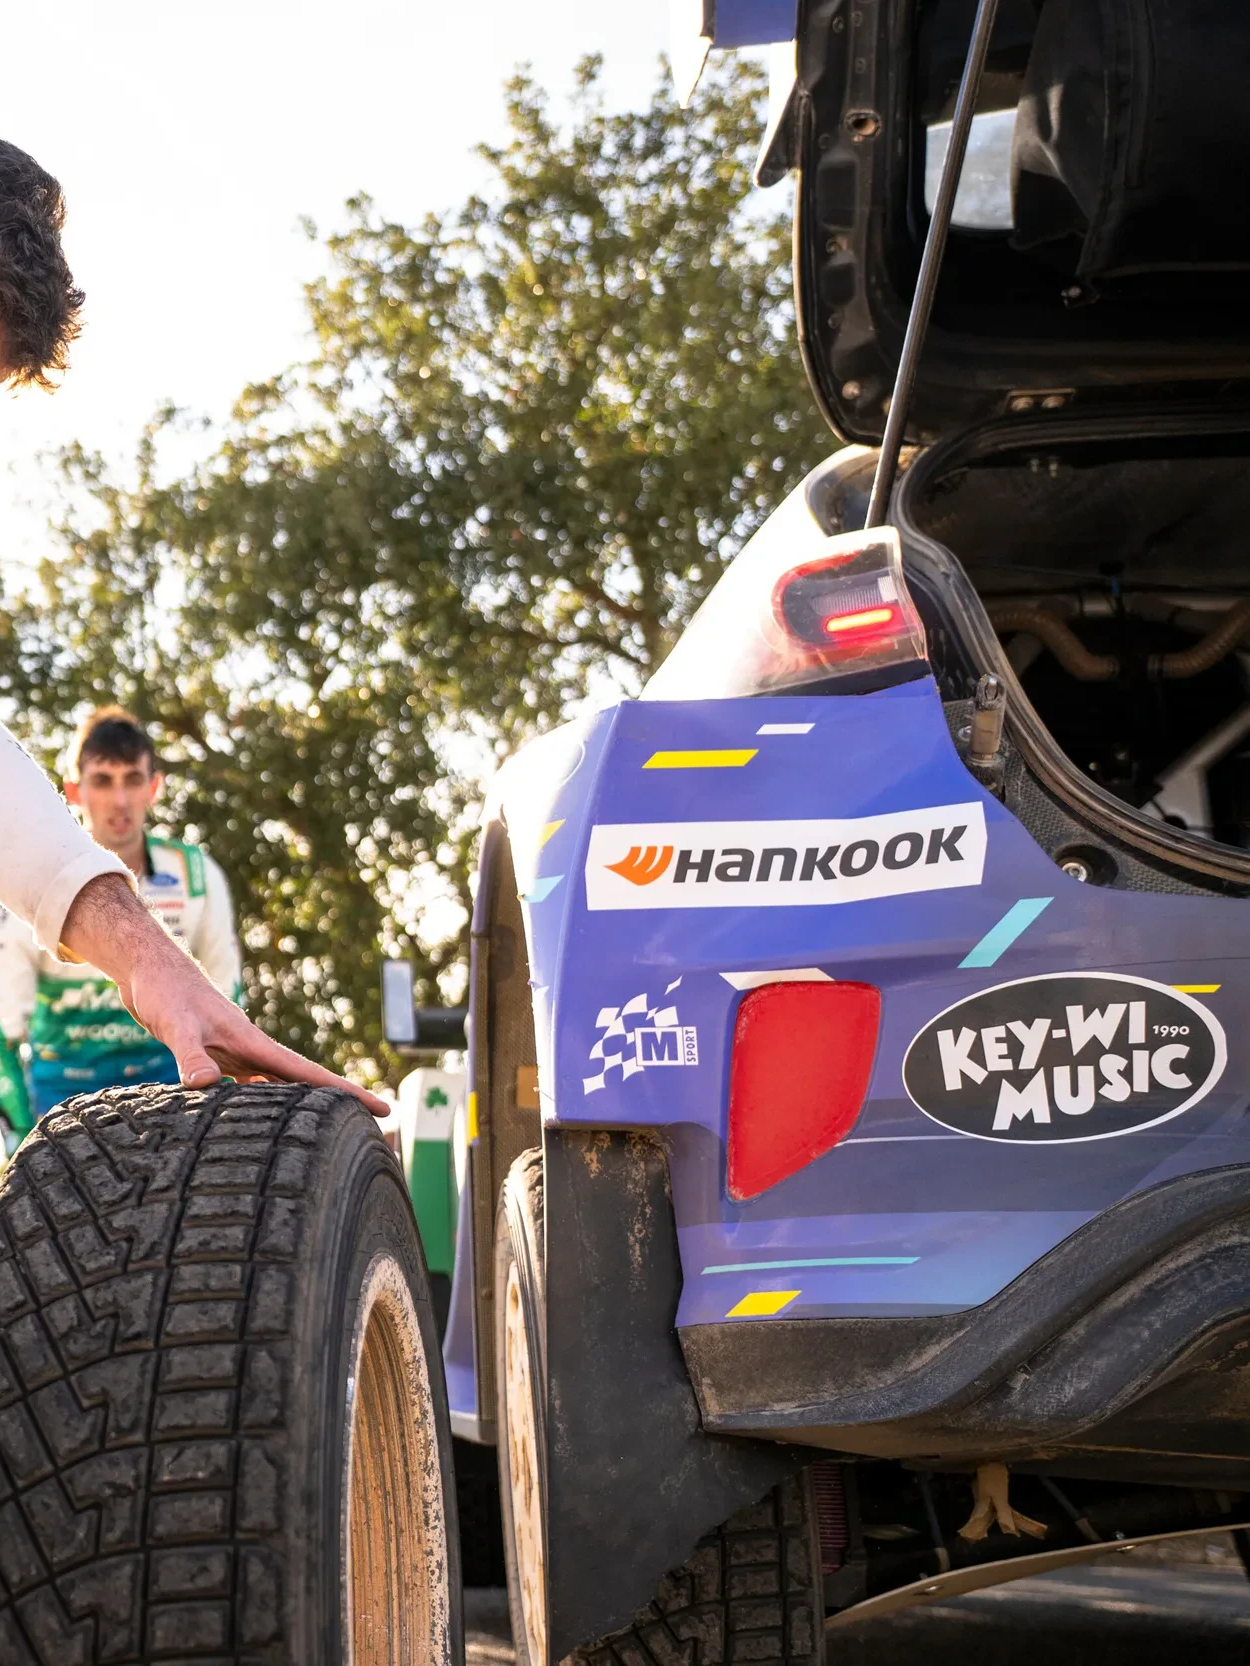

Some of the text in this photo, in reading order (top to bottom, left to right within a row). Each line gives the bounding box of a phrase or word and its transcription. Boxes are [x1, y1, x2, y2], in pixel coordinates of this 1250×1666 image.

[641, 1031, 679, 1062] M
[685, 1029, 697, 1063] SPORT
[937, 1001, 1190, 1091] KEY-WI 1990
[992, 1043, 1193, 1131] MUSIC
